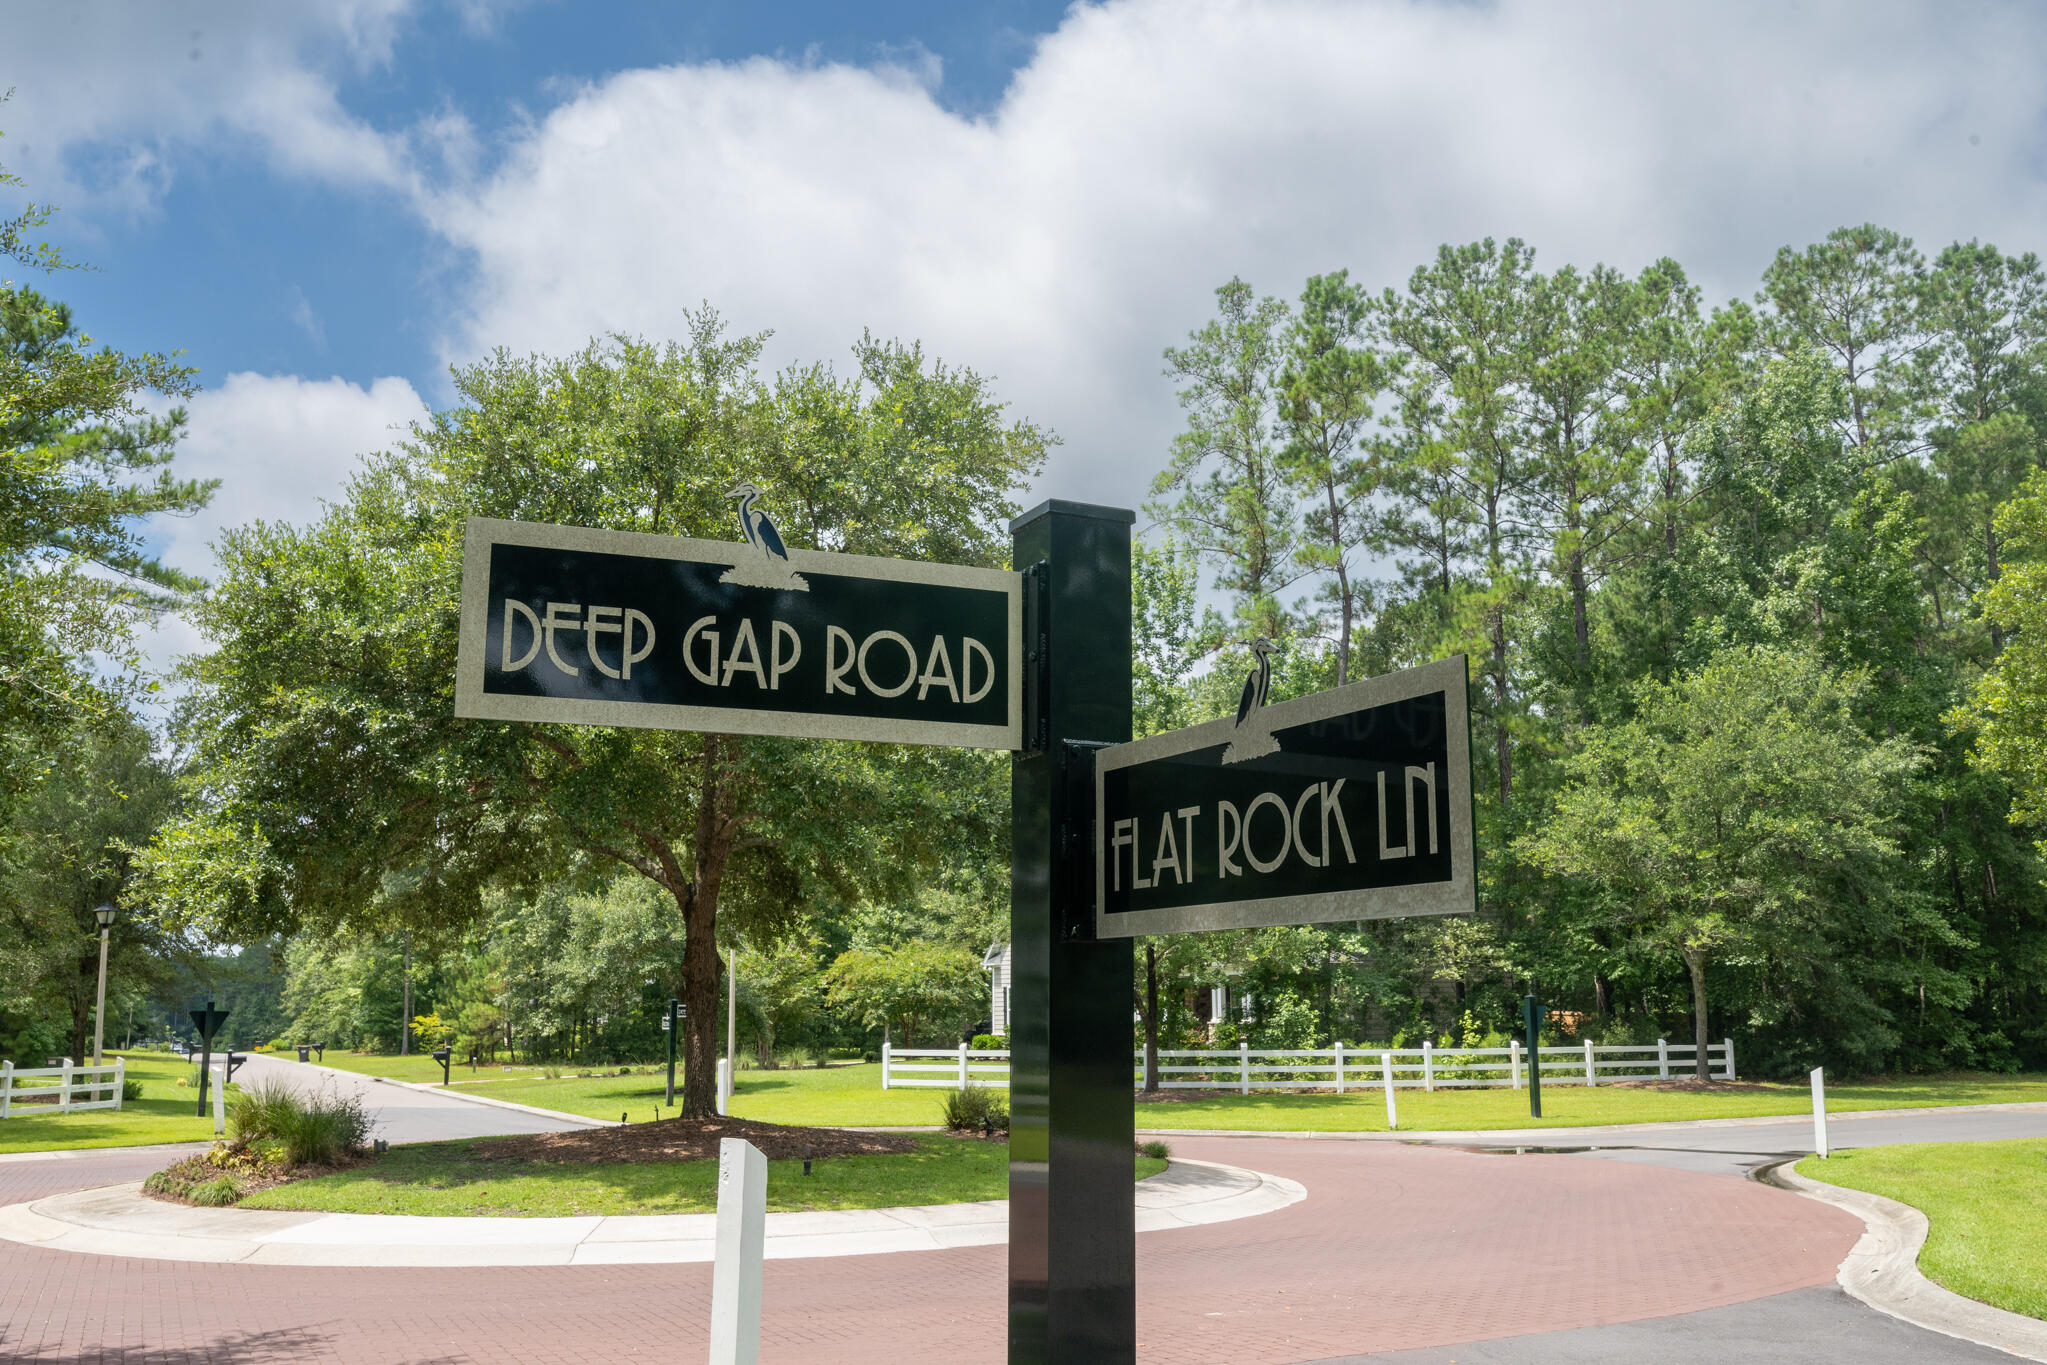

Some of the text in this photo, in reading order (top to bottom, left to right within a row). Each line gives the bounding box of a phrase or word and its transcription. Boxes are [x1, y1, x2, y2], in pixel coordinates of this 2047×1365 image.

[502, 599, 995, 704] DEEP GAP ROAD
[1112, 762, 1438, 891] FLAT ROCK LN
